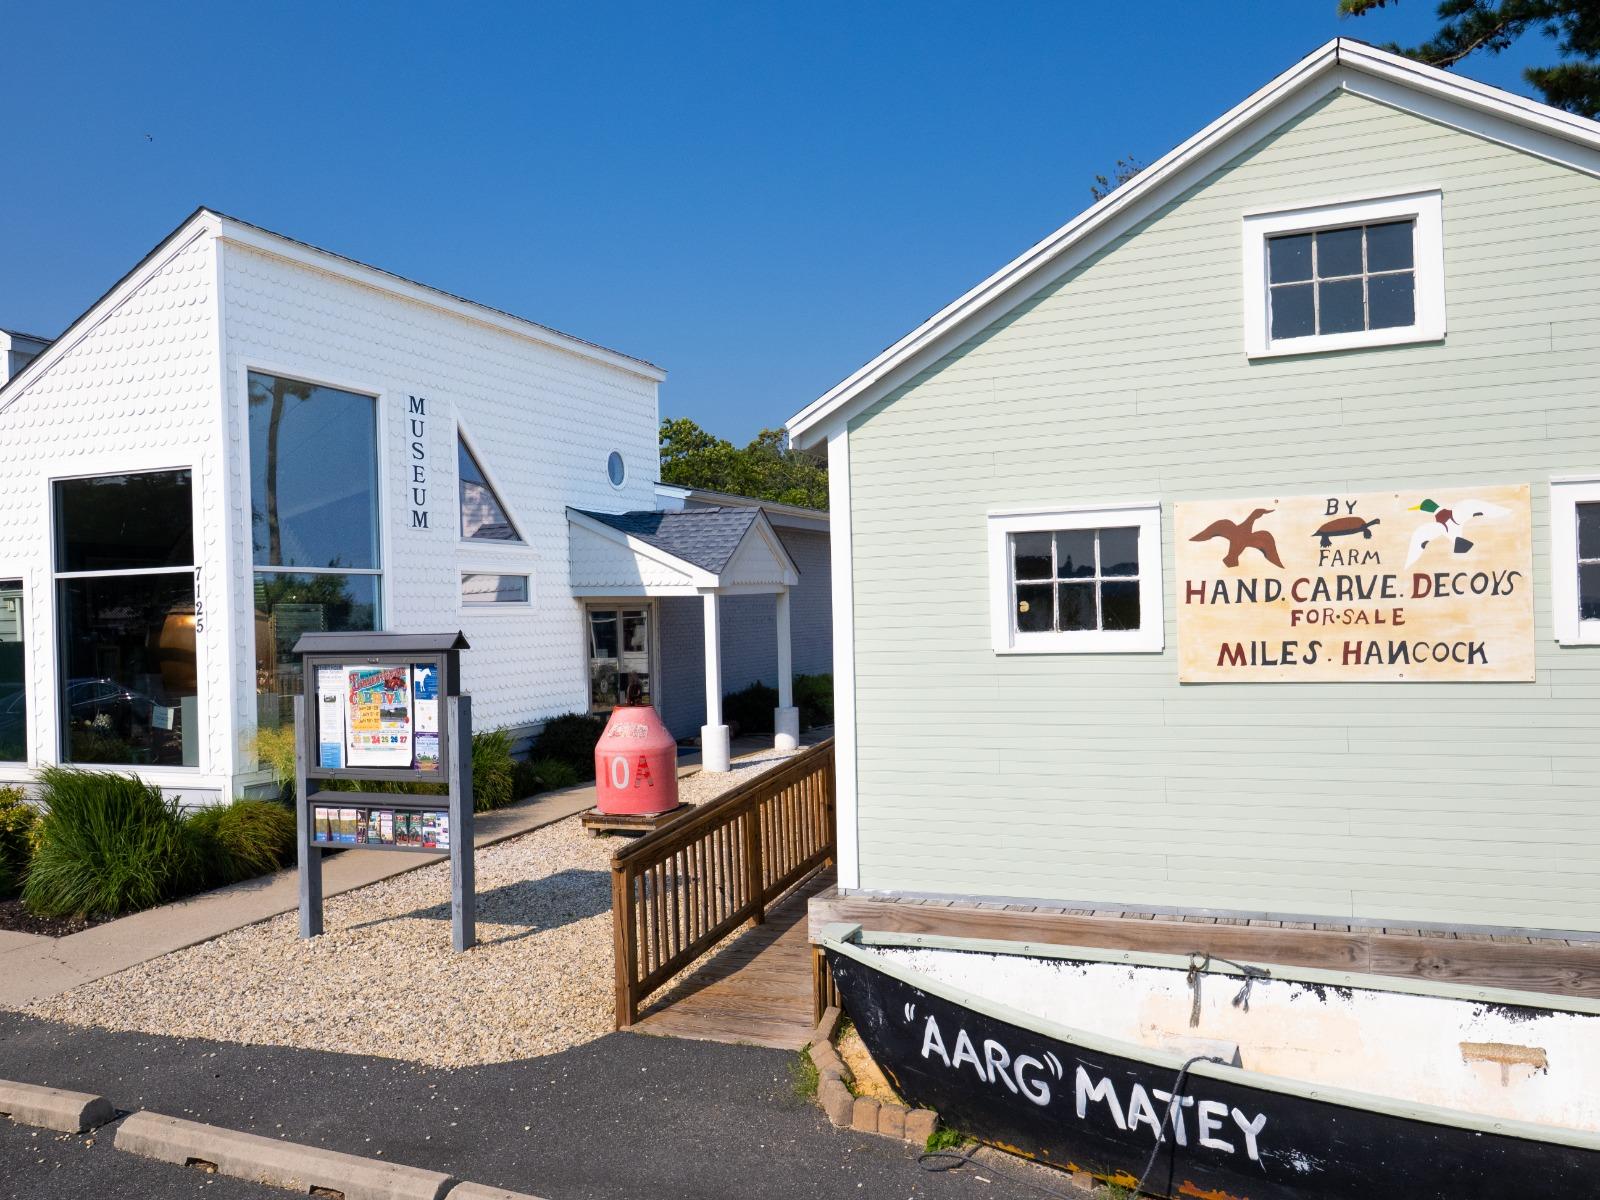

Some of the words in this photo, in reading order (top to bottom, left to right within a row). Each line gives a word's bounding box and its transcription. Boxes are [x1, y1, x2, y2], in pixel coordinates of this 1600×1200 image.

[408, 395, 429, 529] MUSEUM
[1324, 498, 1358, 516] BY
[1318, 548, 1381, 567] FARM
[195, 566, 204, 633] 7125
[1411, 569, 1523, 599] DECOYS
[1075, 1064, 1267, 1161] MATEY
